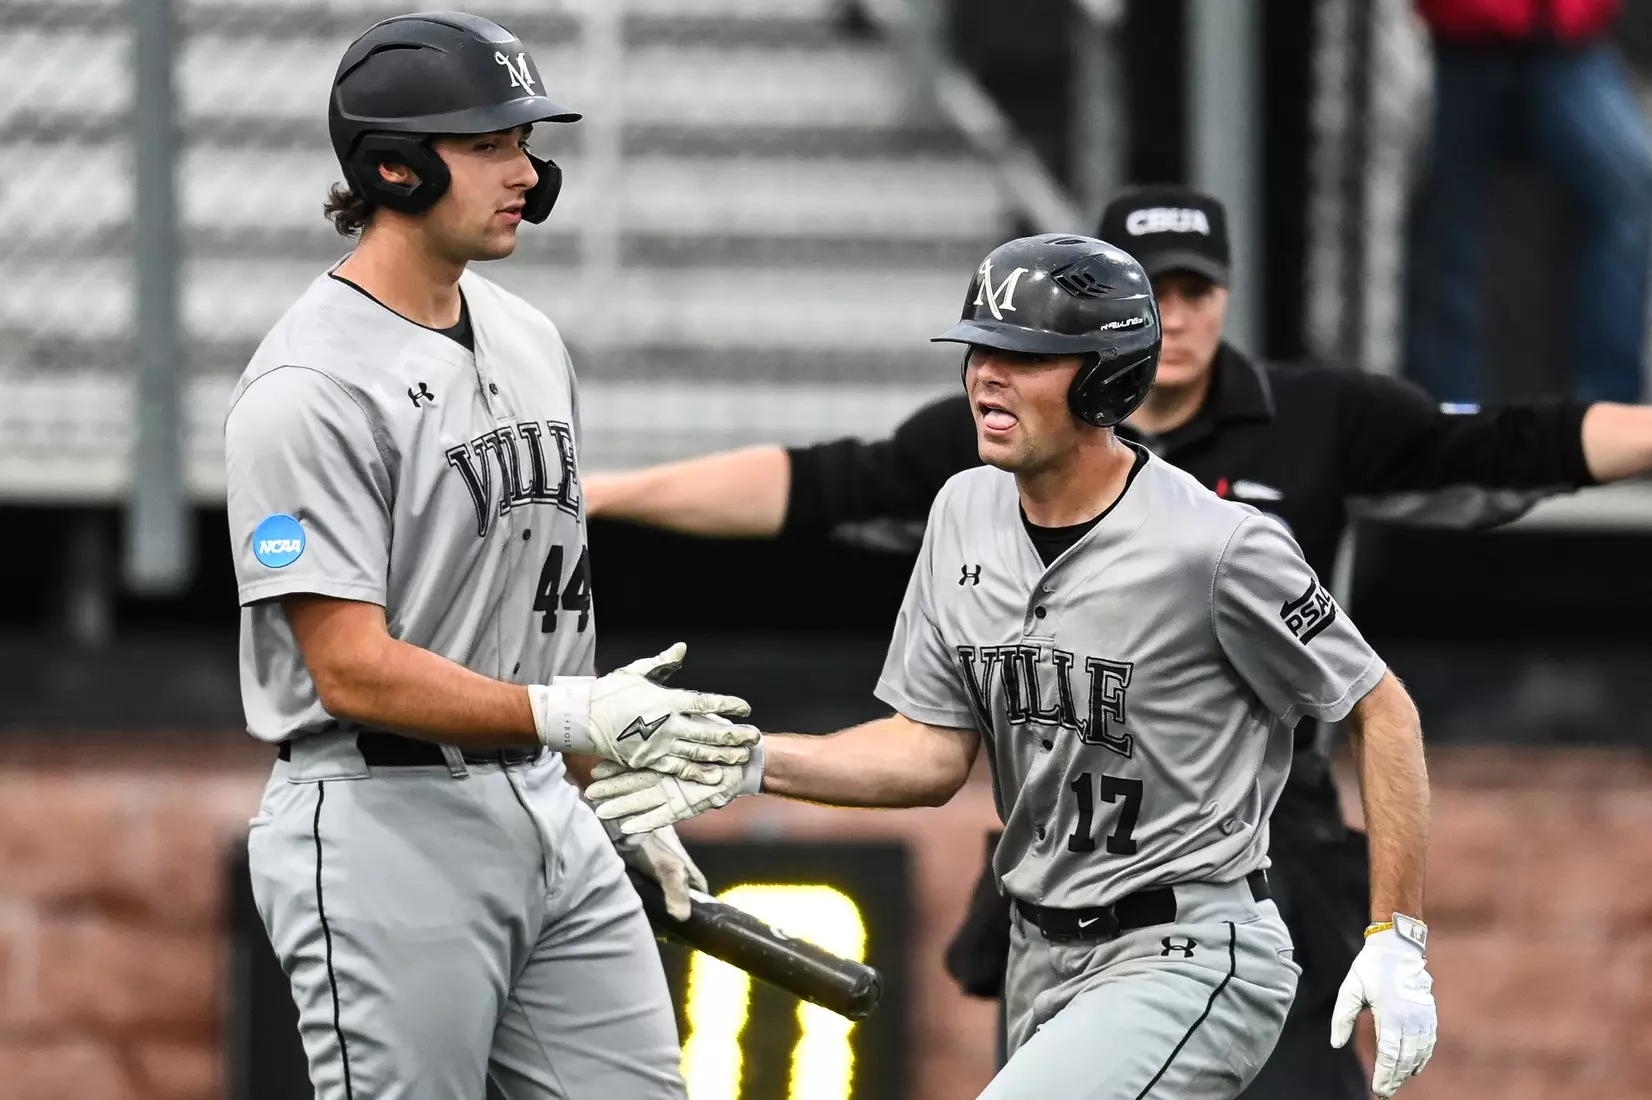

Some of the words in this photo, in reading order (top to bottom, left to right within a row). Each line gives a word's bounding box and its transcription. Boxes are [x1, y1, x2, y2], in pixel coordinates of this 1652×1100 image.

[973, 258, 1028, 320] M
[446, 421, 580, 537] VILLE
[259, 539, 301, 554] NCAA
[533, 545, 591, 633] 44
[957, 644, 1134, 759] VILLE
[1068, 772, 1143, 854] 17
